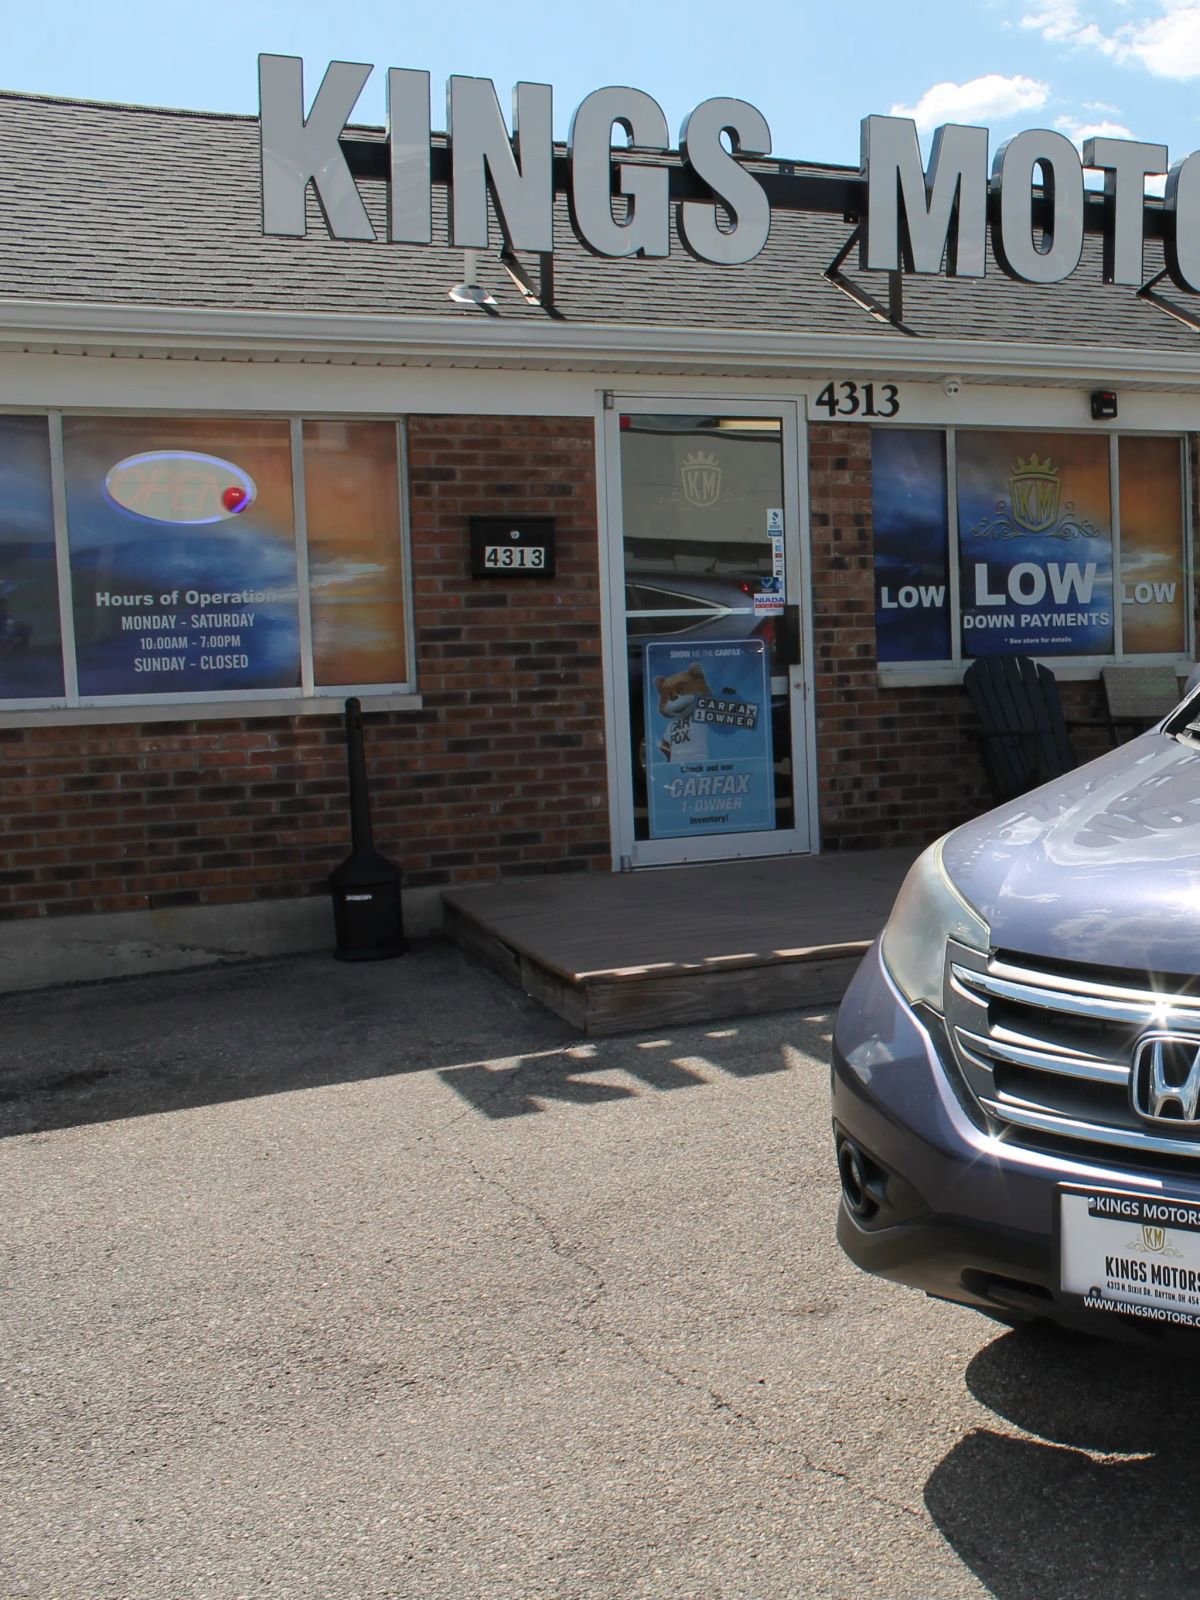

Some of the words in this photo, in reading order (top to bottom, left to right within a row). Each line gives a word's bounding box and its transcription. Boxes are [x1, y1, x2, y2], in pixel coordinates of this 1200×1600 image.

[257, 52, 773, 266] KINGS
[815, 381, 900, 417] 4313
[486, 548, 543, 567] 4313
[974, 562, 1097, 607] LOW
[1119, 582, 1176, 605] LOW
[96, 592, 154, 607] Hours
[159, 590, 180, 606] of
[185, 590, 277, 608] Operation
[881, 586, 946, 609] LOW
[121, 615, 176, 631] MONDAY
[191, 613, 255, 629] SATURDAY
[963, 614, 1015, 630] DOWN
[1021, 612, 1110, 628] PAYMENTS
[141, 636, 188, 650] 10:00AM
[200, 635, 241, 649] 7:00PM
[134, 656, 186, 673] SUNDAY
[201, 654, 249, 670] CLOSED
[670, 650, 691, 658] SHOW
[697, 699, 758, 717] CARFAX
[670, 730, 691, 745] FOX
[669, 774, 750, 798] CARFAX
[682, 797, 743, 813] 1-OWNER
[1096, 1197, 1140, 1216] KINGS
[1145, 1227, 1163, 1248] KM
[1105, 1256, 1148, 1283] KINGS
[1106, 1280, 1120, 1291] 4313
[1178, 1294, 1186, 1303] OH
